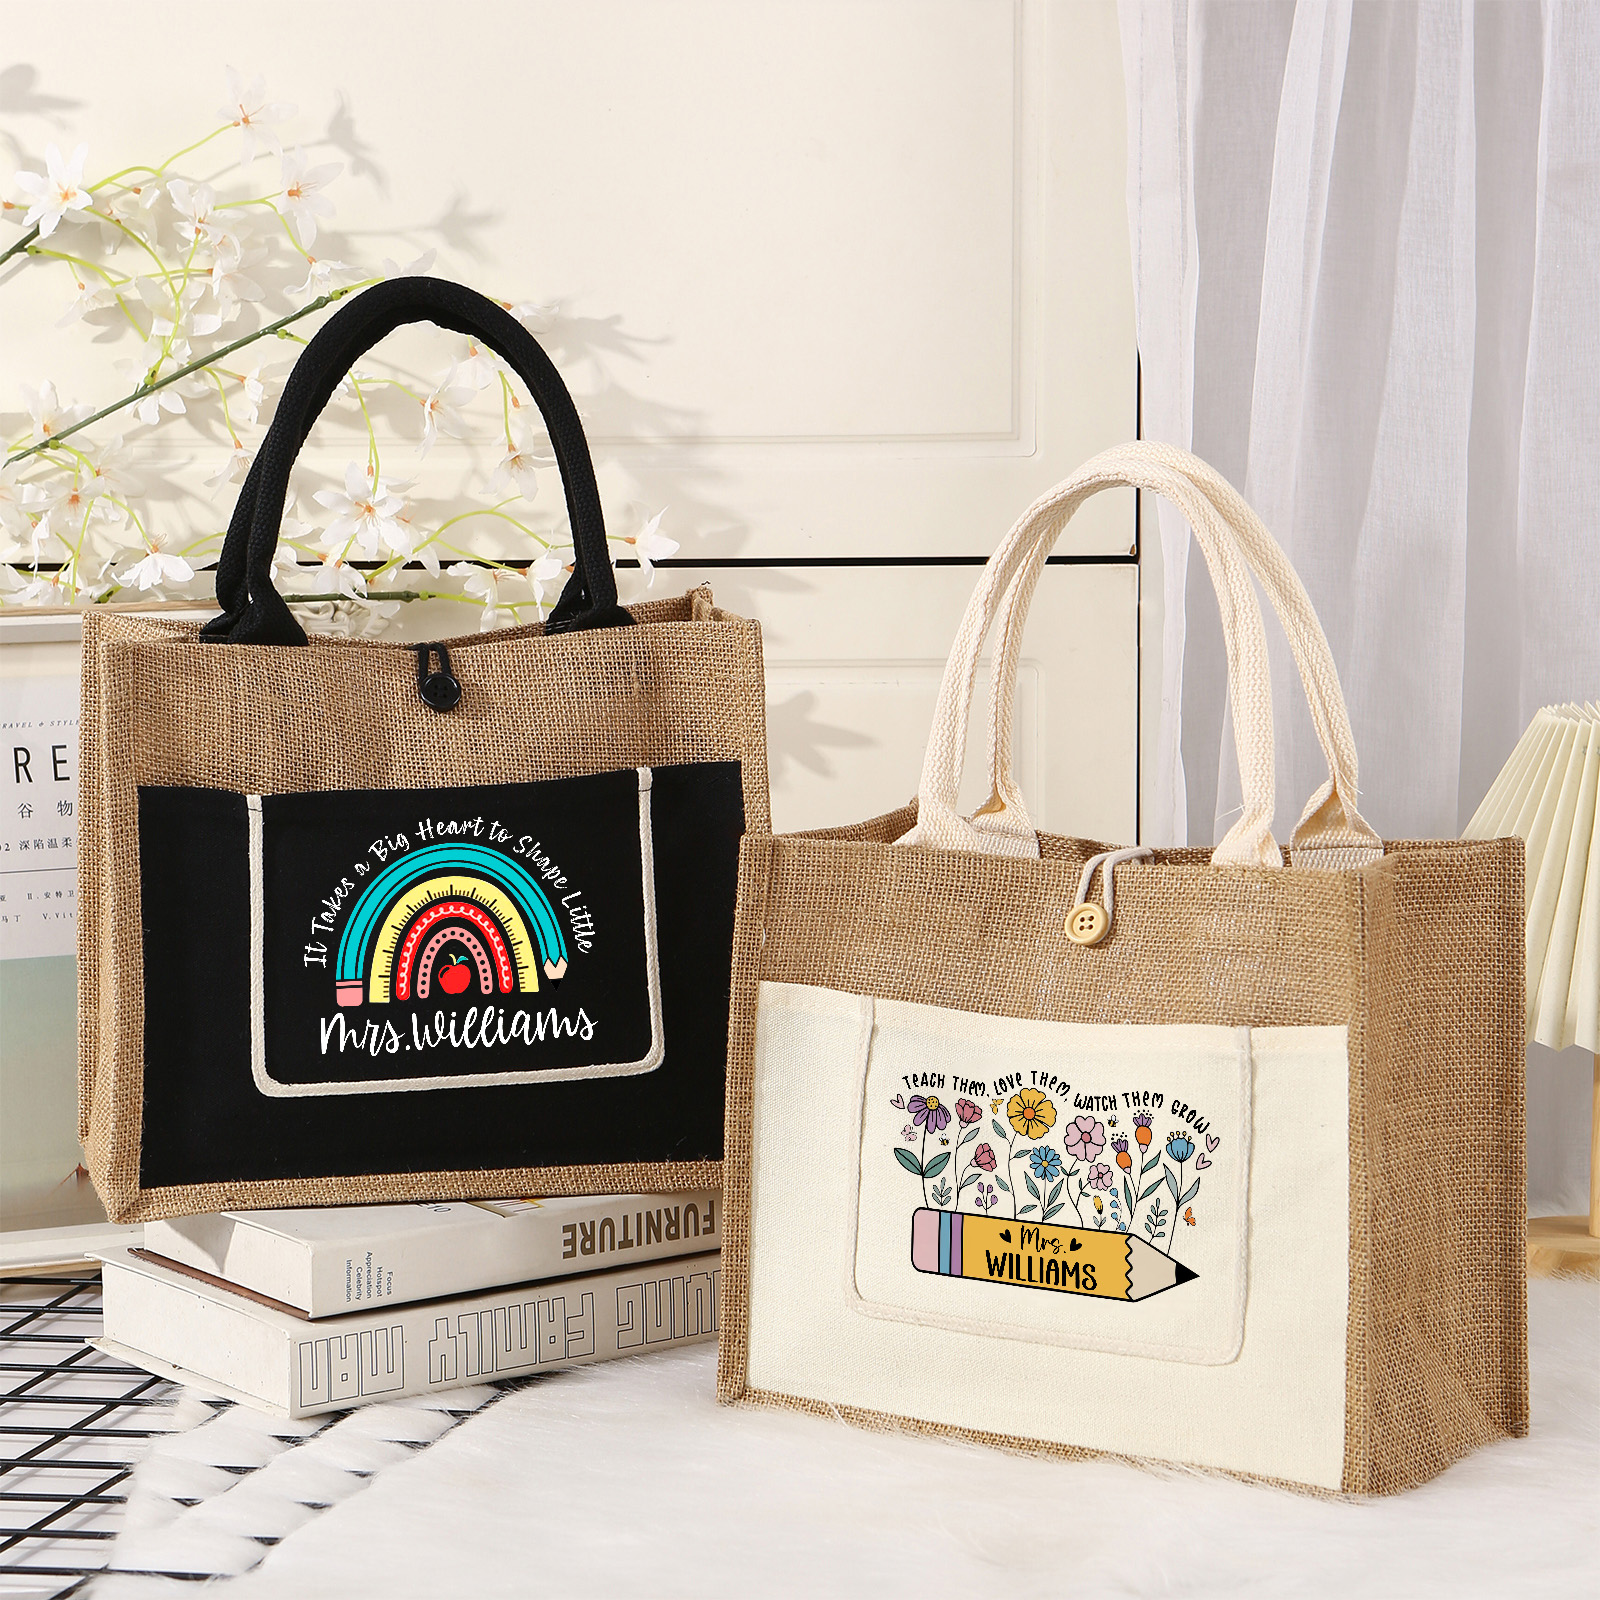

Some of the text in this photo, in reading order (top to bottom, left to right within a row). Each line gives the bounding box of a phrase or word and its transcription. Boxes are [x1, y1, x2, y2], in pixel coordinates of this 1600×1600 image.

[0, 721, 33, 729] RAVEL
[17, 800, 73, 819] 谷物
[19, 836, 78, 851] 深陷温柔
[303, 816, 596, 968] It Takes a Big Heart to Shape Little
[1073, 1093, 1117, 1111] WATCH
[1171, 1099, 1210, 1134] GROW
[562, 1200, 715, 1260] FURNITURE
[1020, 1225, 1067, 1255] Mrs.
[355, 1266, 363, 1301] Celebrity
[365, 1251, 373, 1299] Appreciation
[375, 1266, 383, 1298] Hotspot
[386, 1271, 394, 1296] Focus
[985, 1249, 1098, 1291] WILLIAMS
[429, 1292, 595, 1384] FAMILY
[299, 1325, 405, 1408] MAN
